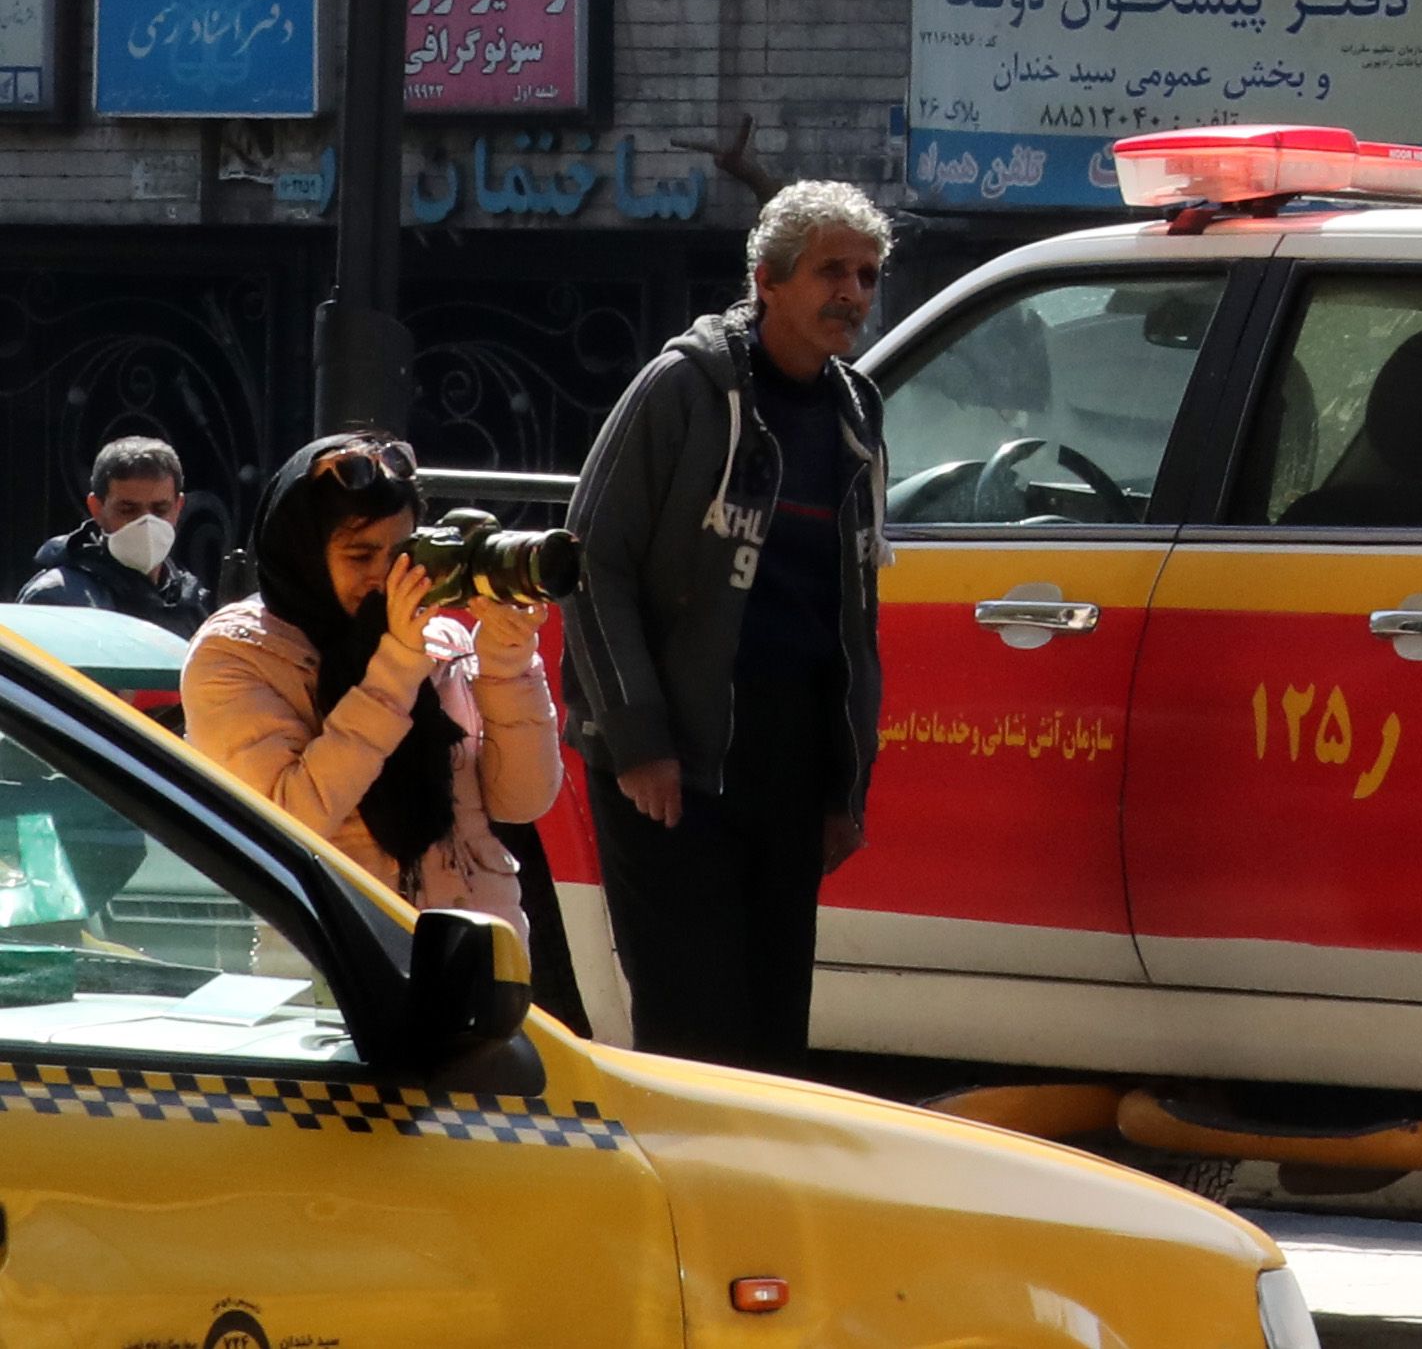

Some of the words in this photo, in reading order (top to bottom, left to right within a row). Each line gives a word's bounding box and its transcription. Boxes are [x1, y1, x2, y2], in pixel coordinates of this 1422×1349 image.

[127, 2, 182, 61] رسمی
[190, 3, 243, 46] اسناد
[404, 24, 544, 75] سونوگرافی
[992, 54, 1061, 93] خندان
[1069, 65, 1117, 91] سید
[1124, 66, 1212, 97] عمومی
[1223, 59, 1306, 101] بخش
[1315, 78, 1331, 100] و
[729, 544, 760, 590] 9
[981, 712, 1028, 757] نشانی
[1027, 709, 1065, 762] آتش
[1062, 717, 1115, 762] سازمان
[1252, 682, 1354, 765] ۱۲۵
